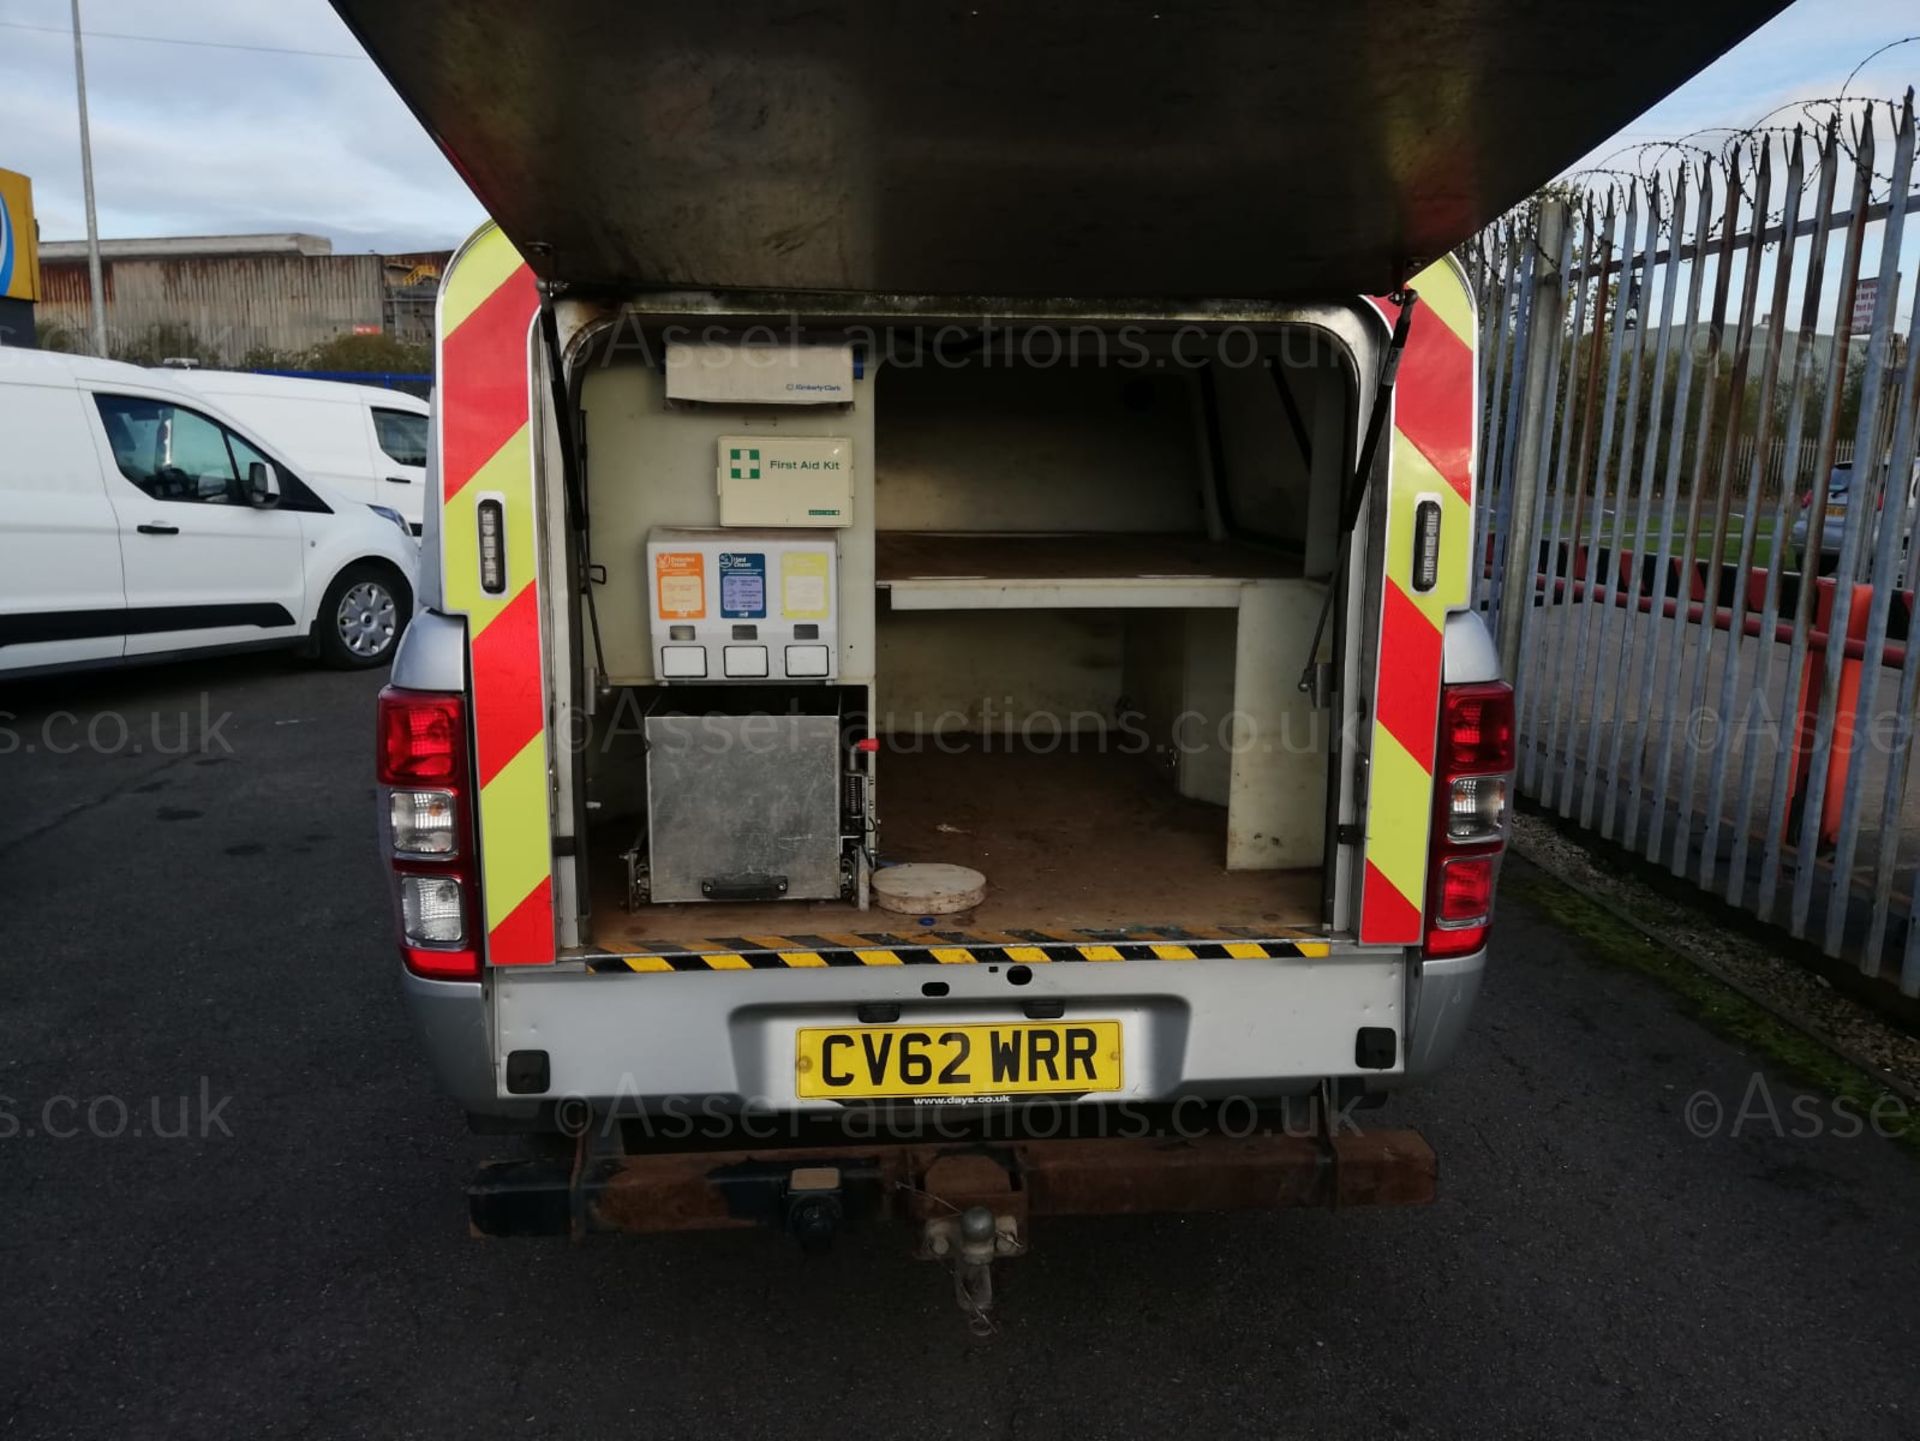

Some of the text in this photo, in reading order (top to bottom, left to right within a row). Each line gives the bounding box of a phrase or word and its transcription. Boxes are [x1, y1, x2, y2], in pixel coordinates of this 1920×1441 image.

[769, 460, 840, 470] First Aid Kit
[822, 1028, 1098, 1087] CV62 WRR
[913, 1093, 1011, 1107] www.days.co.uk
